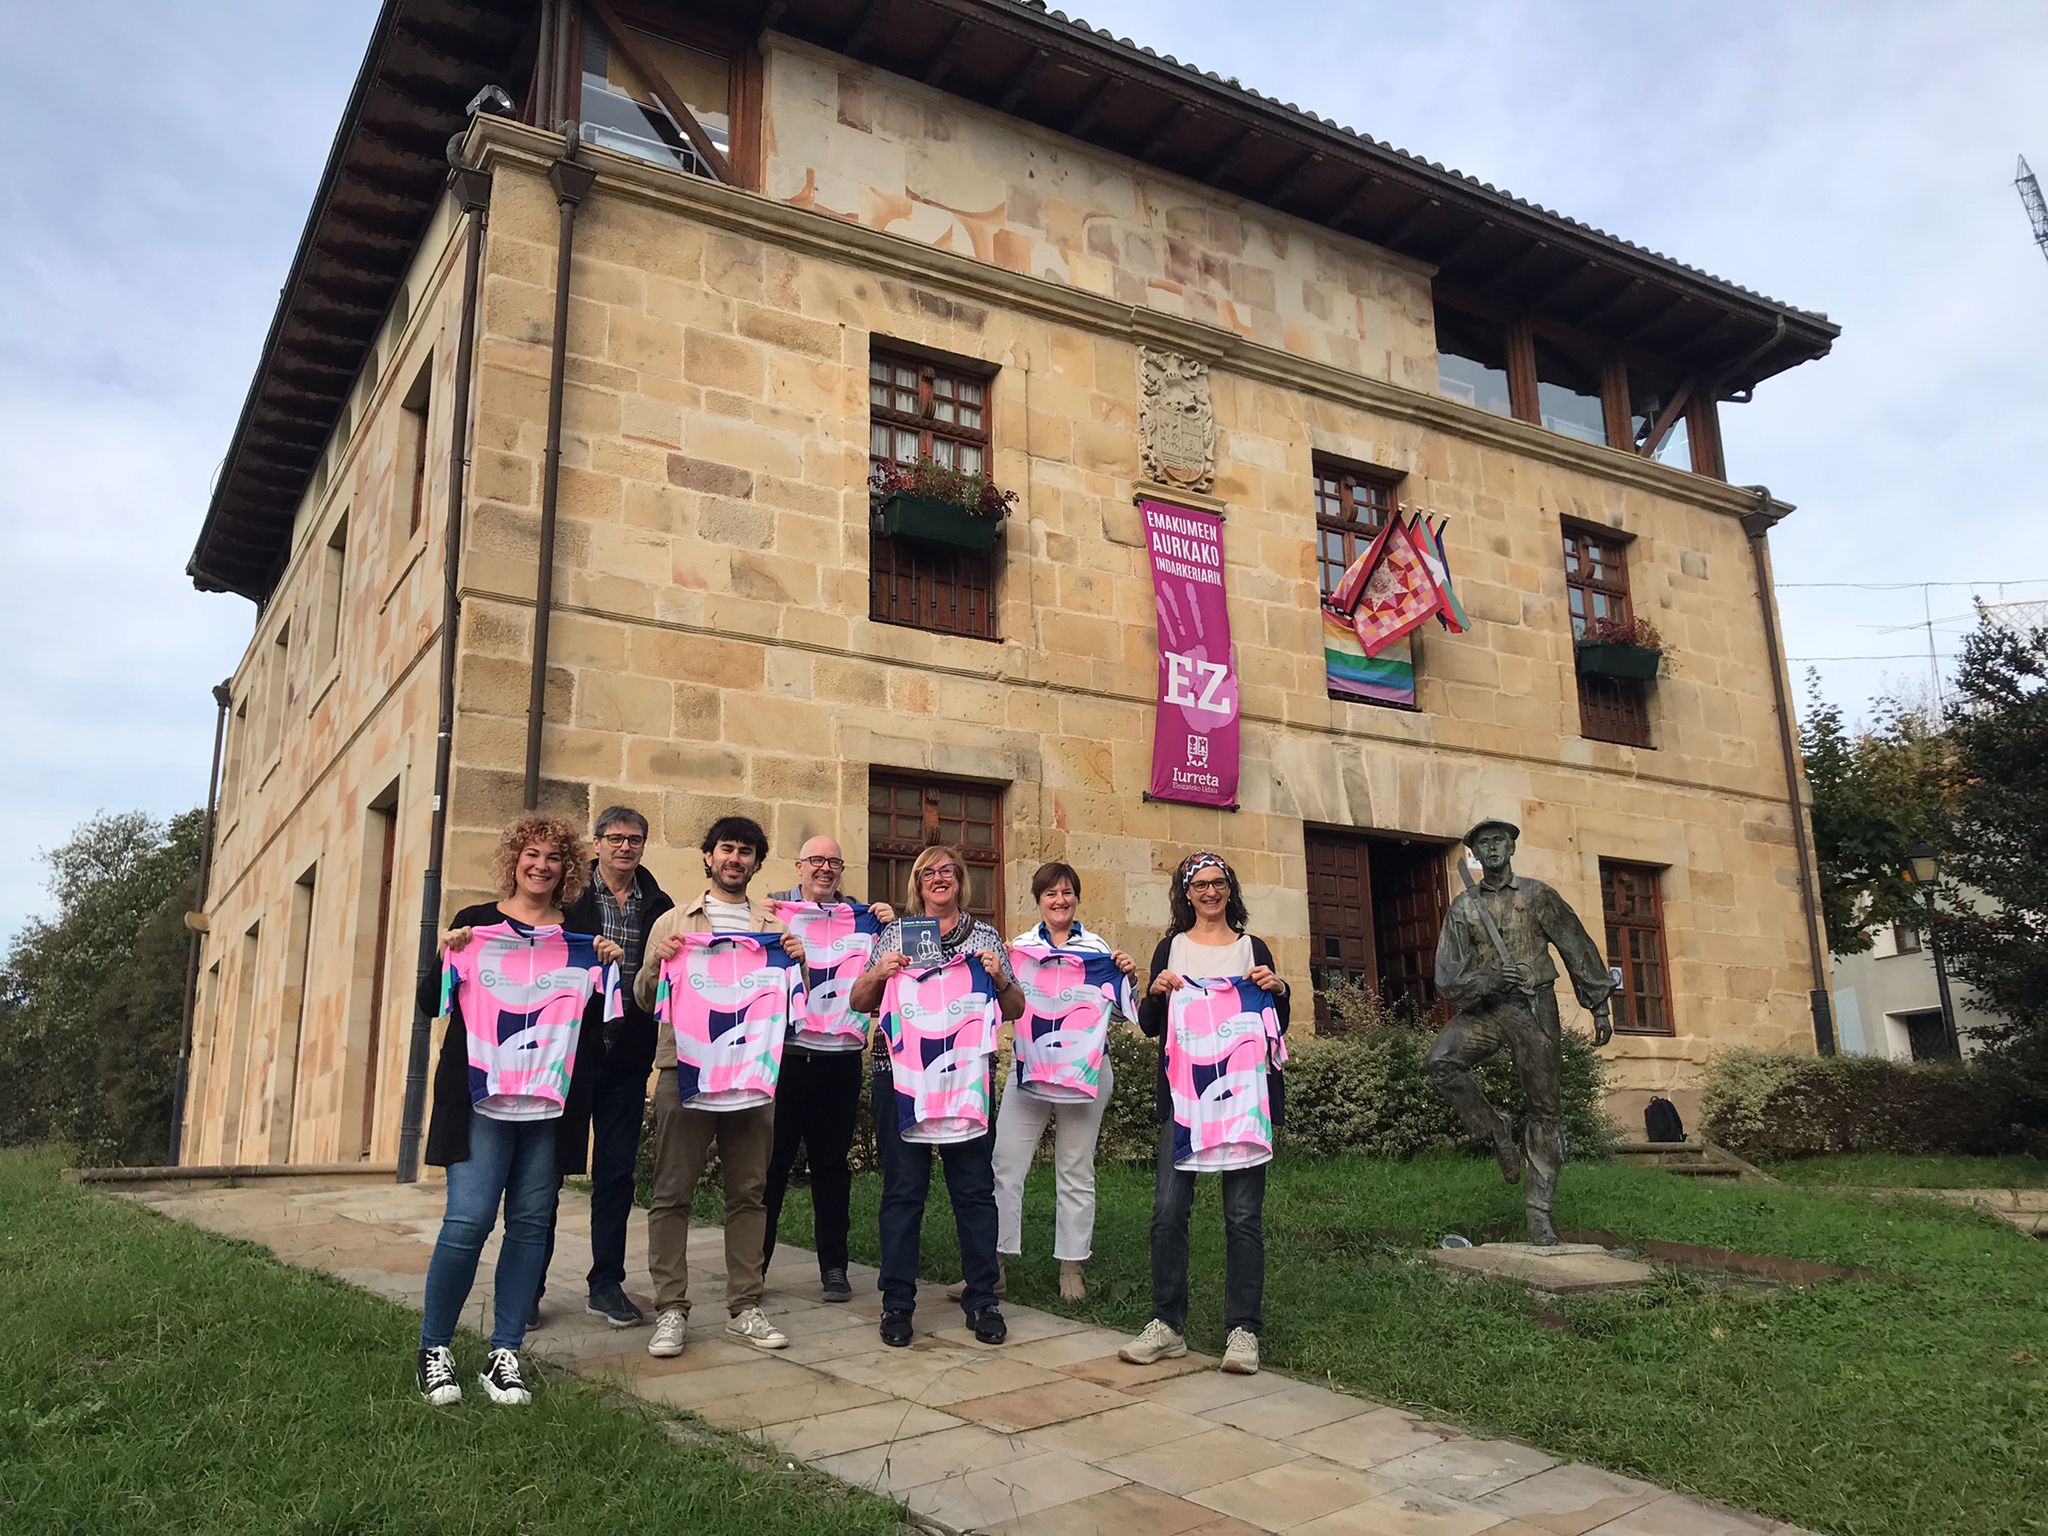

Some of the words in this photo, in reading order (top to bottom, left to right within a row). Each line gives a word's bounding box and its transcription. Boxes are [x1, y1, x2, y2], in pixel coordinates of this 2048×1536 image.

[1146, 511, 1218, 543] EMAKUMEEN
[1152, 531, 1220, 567] AURKAKO
[1155, 556, 1222, 587] INDARKERIARIK
[1163, 651, 1231, 714] EZ
[1172, 767, 1219, 787] Iurreta
